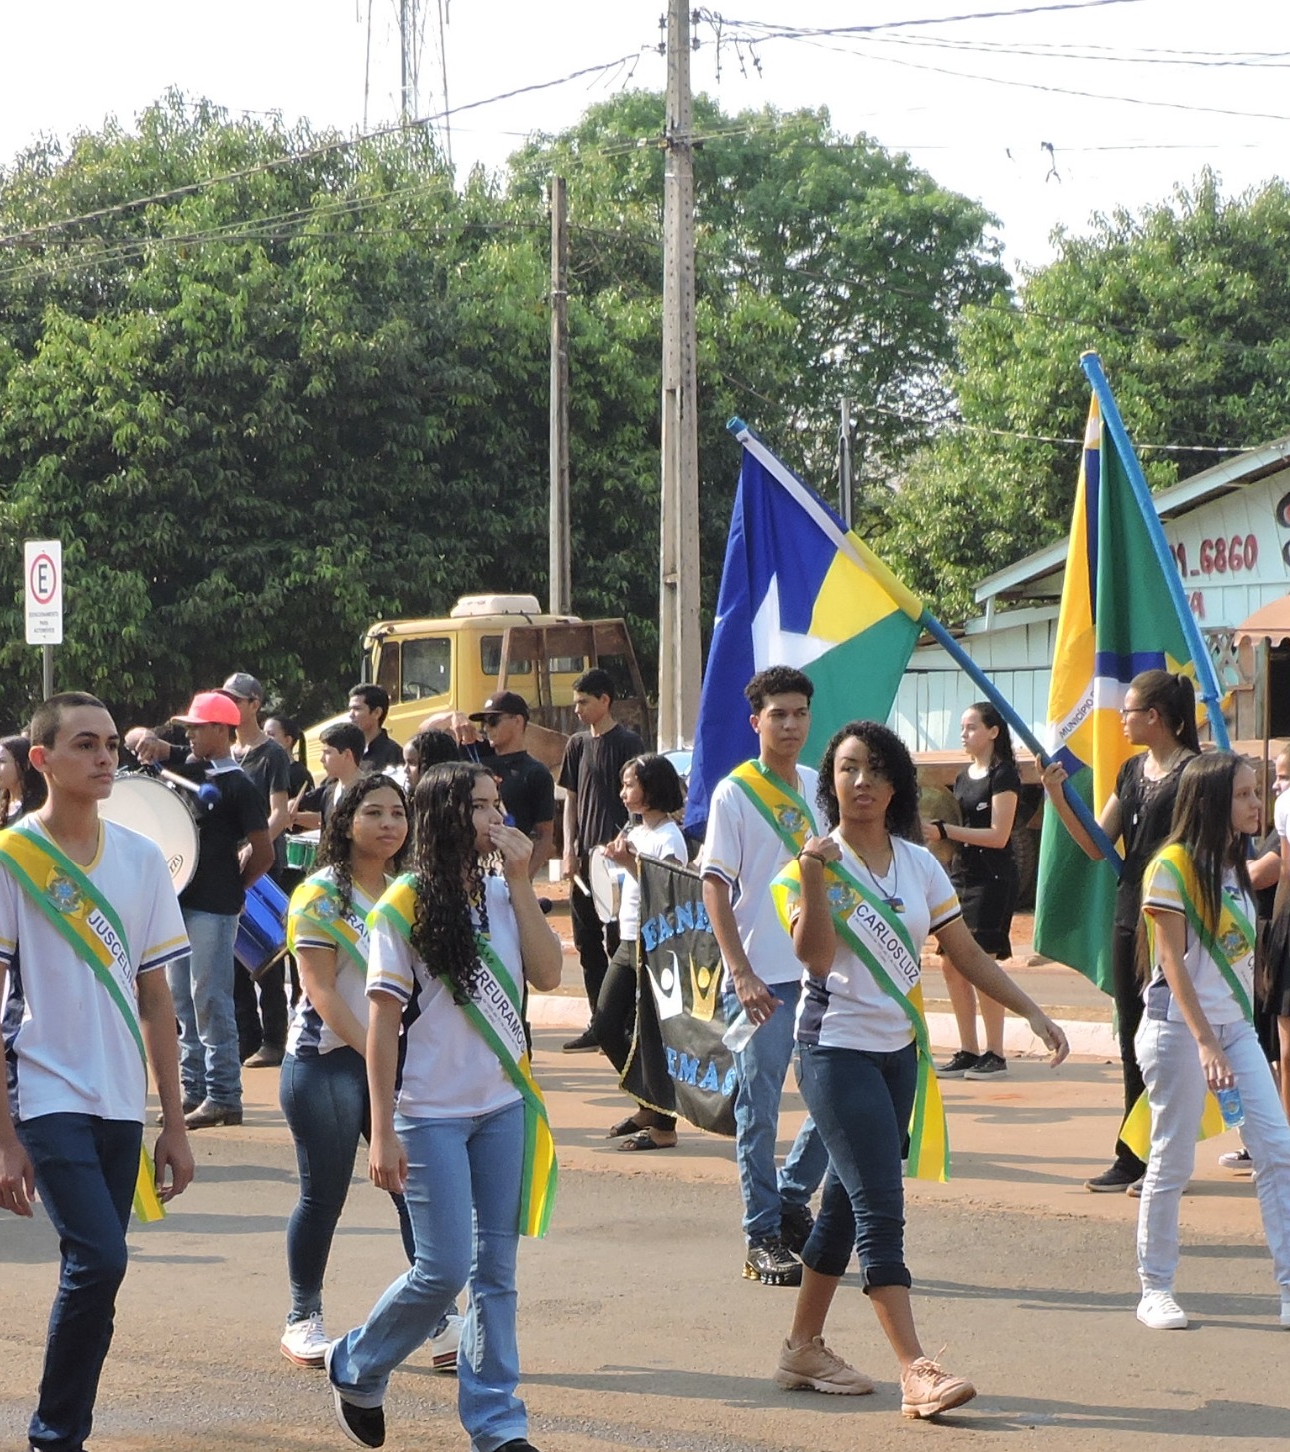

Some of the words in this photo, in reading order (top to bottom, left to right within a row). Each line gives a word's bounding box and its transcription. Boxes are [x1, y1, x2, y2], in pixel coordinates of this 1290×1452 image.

[38, 563, 48, 594] E
[640, 900, 713, 952] FANF
[856, 904, 904, 960] CARLOS
[898, 954, 920, 984] LUZ
